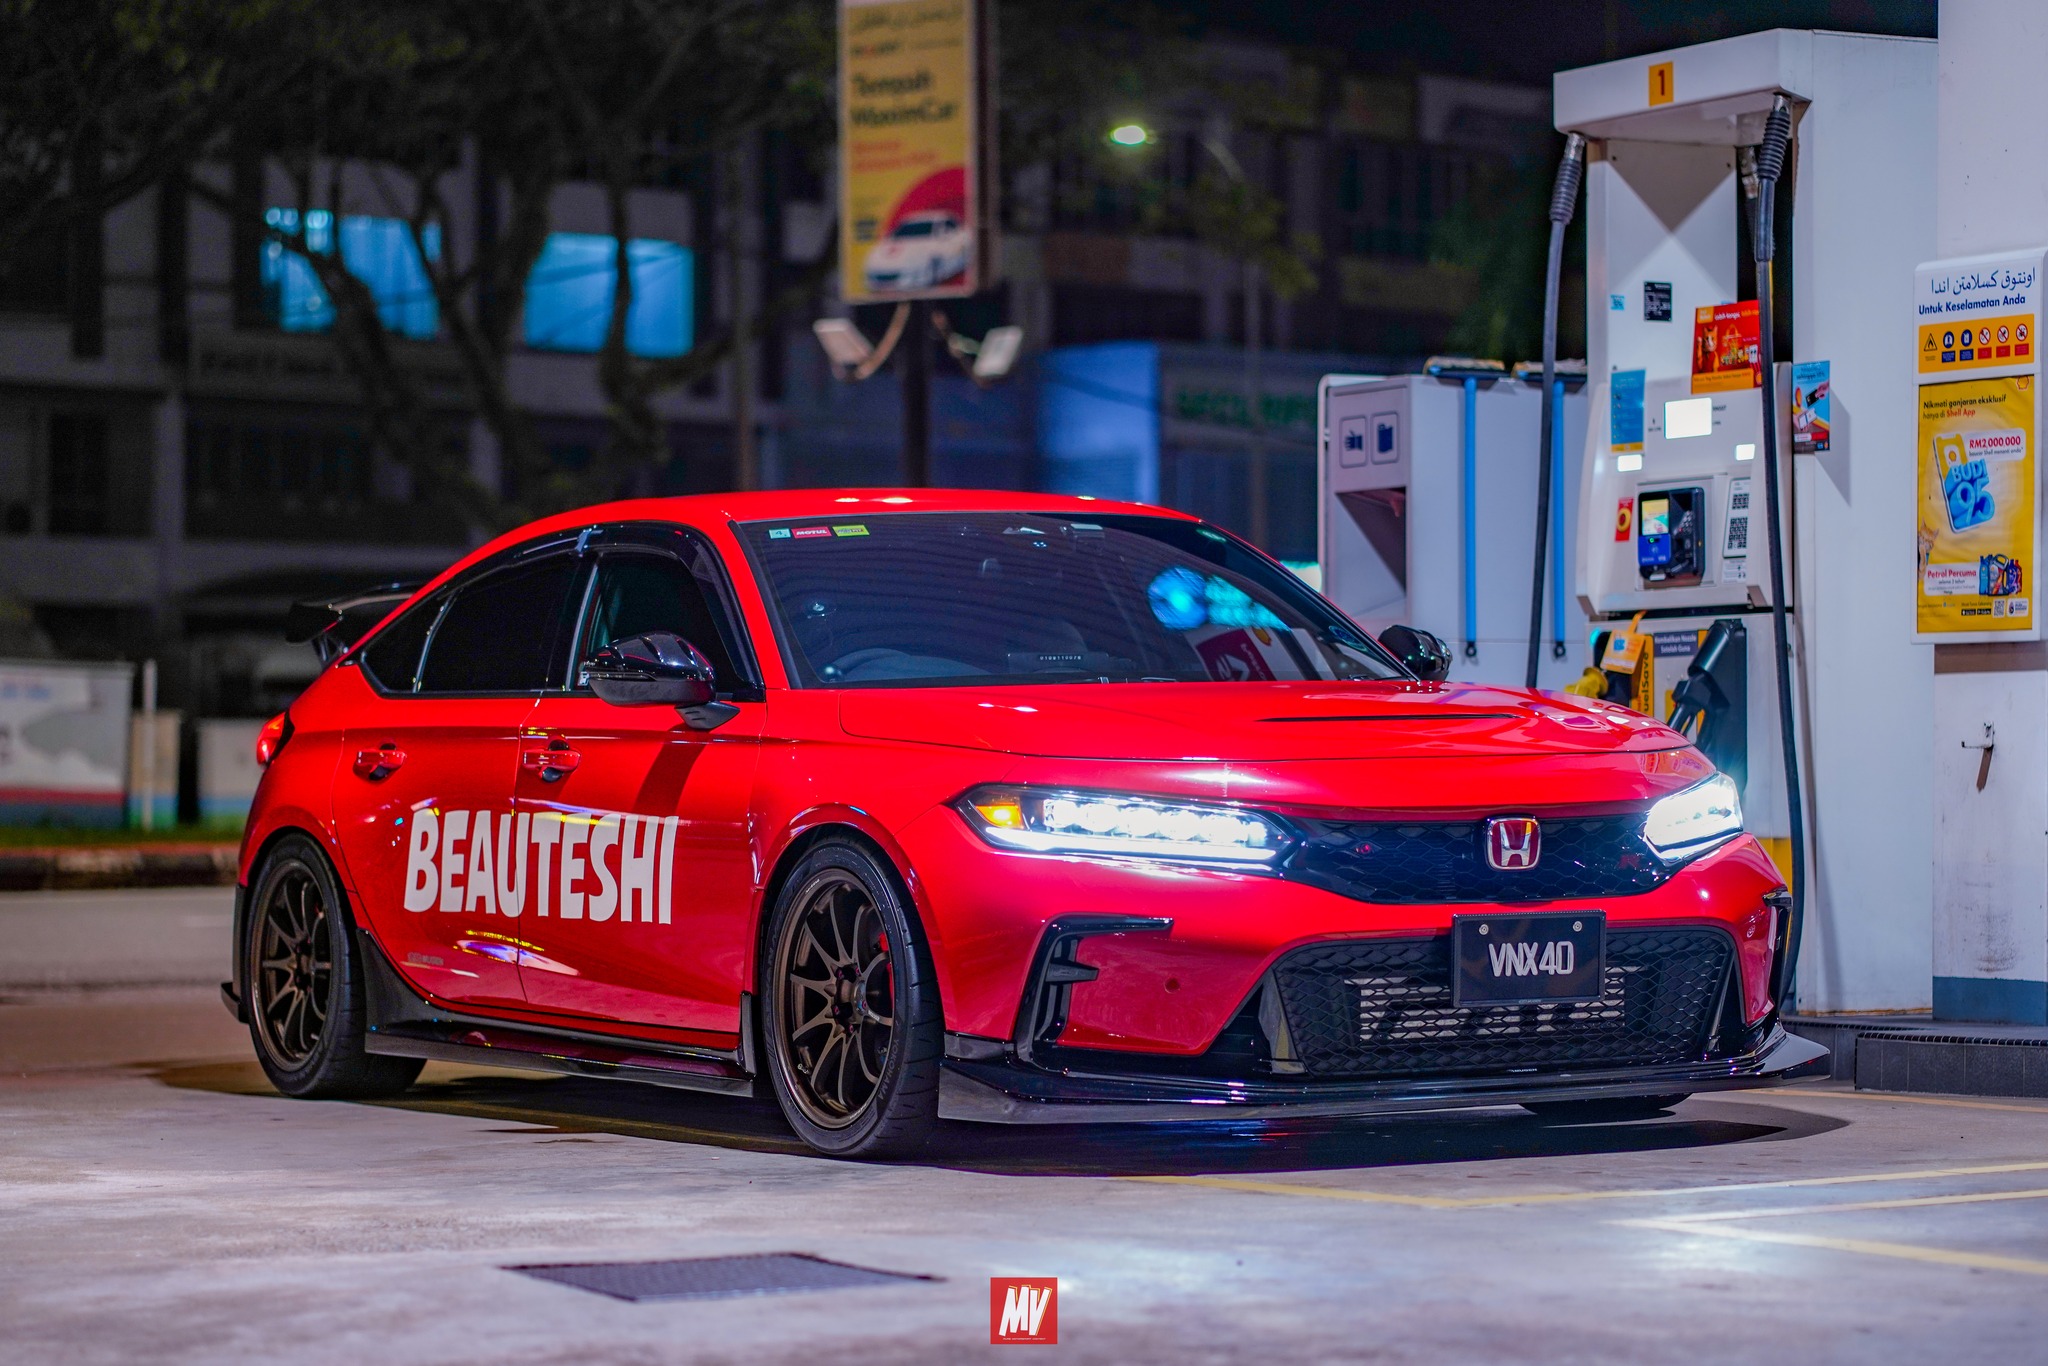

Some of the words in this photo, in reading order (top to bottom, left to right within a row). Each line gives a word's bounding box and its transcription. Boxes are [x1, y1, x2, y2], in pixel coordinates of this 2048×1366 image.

[1658, 69, 1665, 96] 1
[1919, 302, 1943, 315] Untuk
[1945, 297, 2000, 313] Keselamatan
[2002, 292, 2026, 306] Anda
[1923, 399, 1948, 409] Nikmati
[1948, 396, 1977, 409] ganjaran
[1978, 394, 2007, 404] eksklusif
[1923, 411, 1939, 420] hanya
[1940, 409, 1946, 418] di
[1946, 408, 1962, 418] Shell
[1963, 408, 1976, 418] App
[1952, 458, 1988, 482] BUDI
[1956, 480, 1995, 528] 95
[1927, 569, 1947, 579] Petrol
[1948, 568, 1977, 578] Percuma
[403, 807, 680, 925] BEAUTESHI
[1488, 940, 1575, 977] VNX40
[877, 1038, 900, 1100] YOKOHAMA
